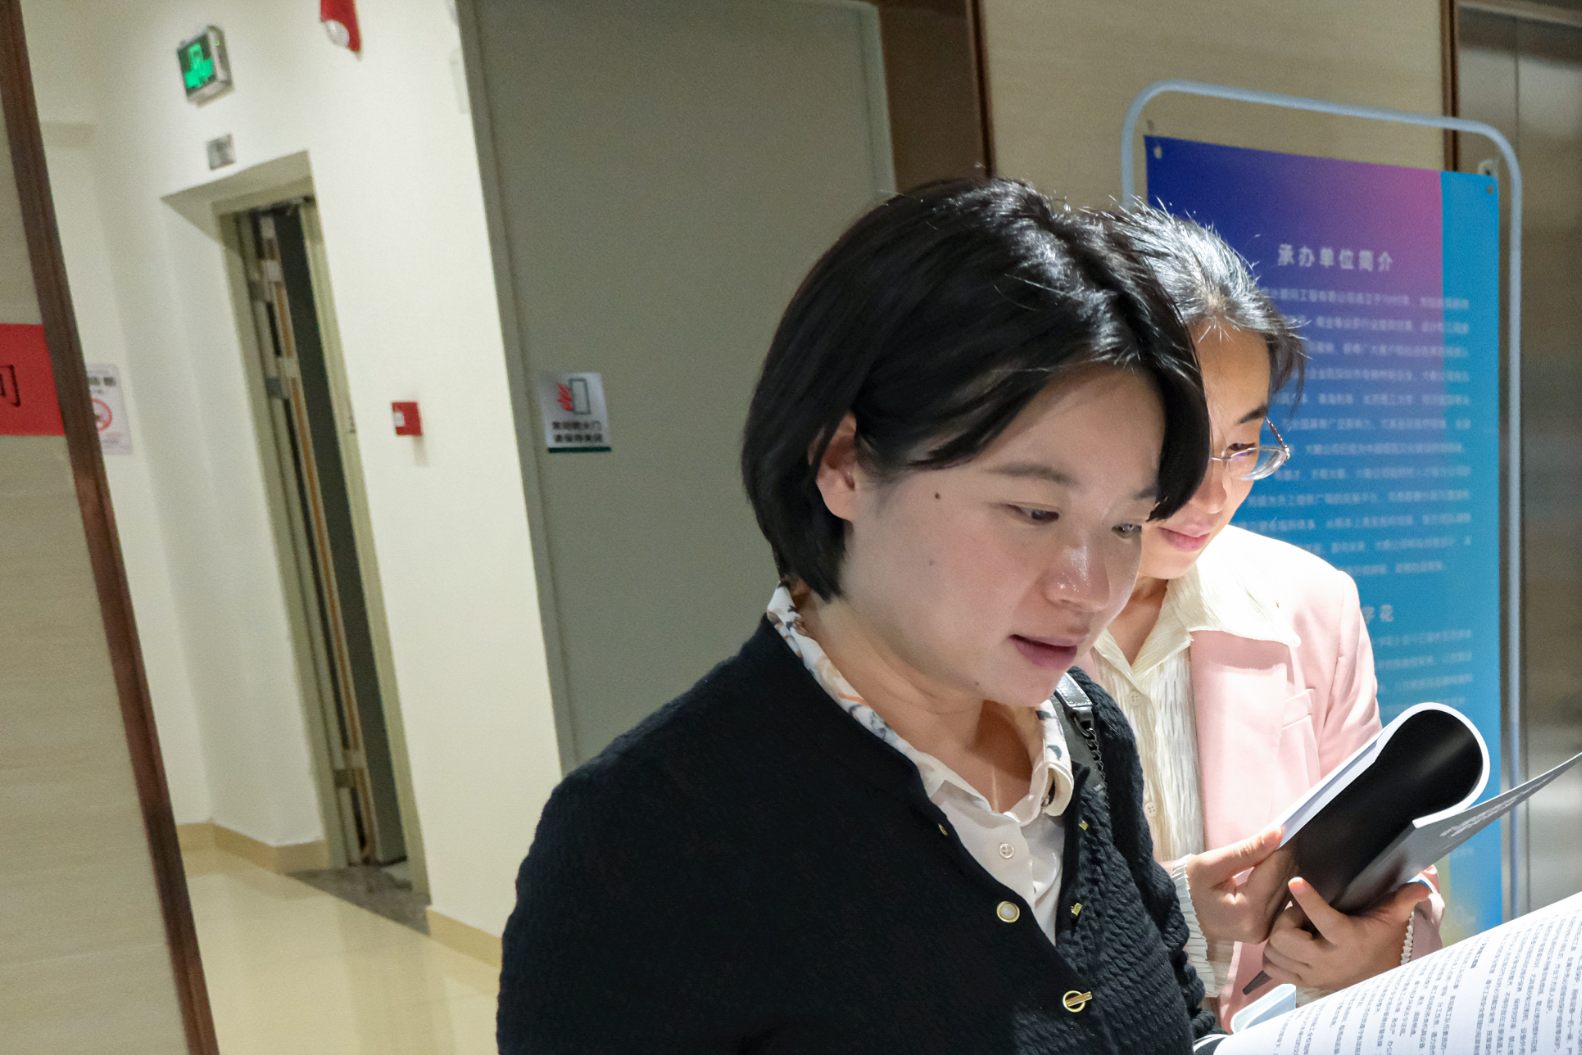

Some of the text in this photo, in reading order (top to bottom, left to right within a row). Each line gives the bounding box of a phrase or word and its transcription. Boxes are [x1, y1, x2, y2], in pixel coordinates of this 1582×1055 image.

[1277, 243, 1393, 272] 承办单位简介
